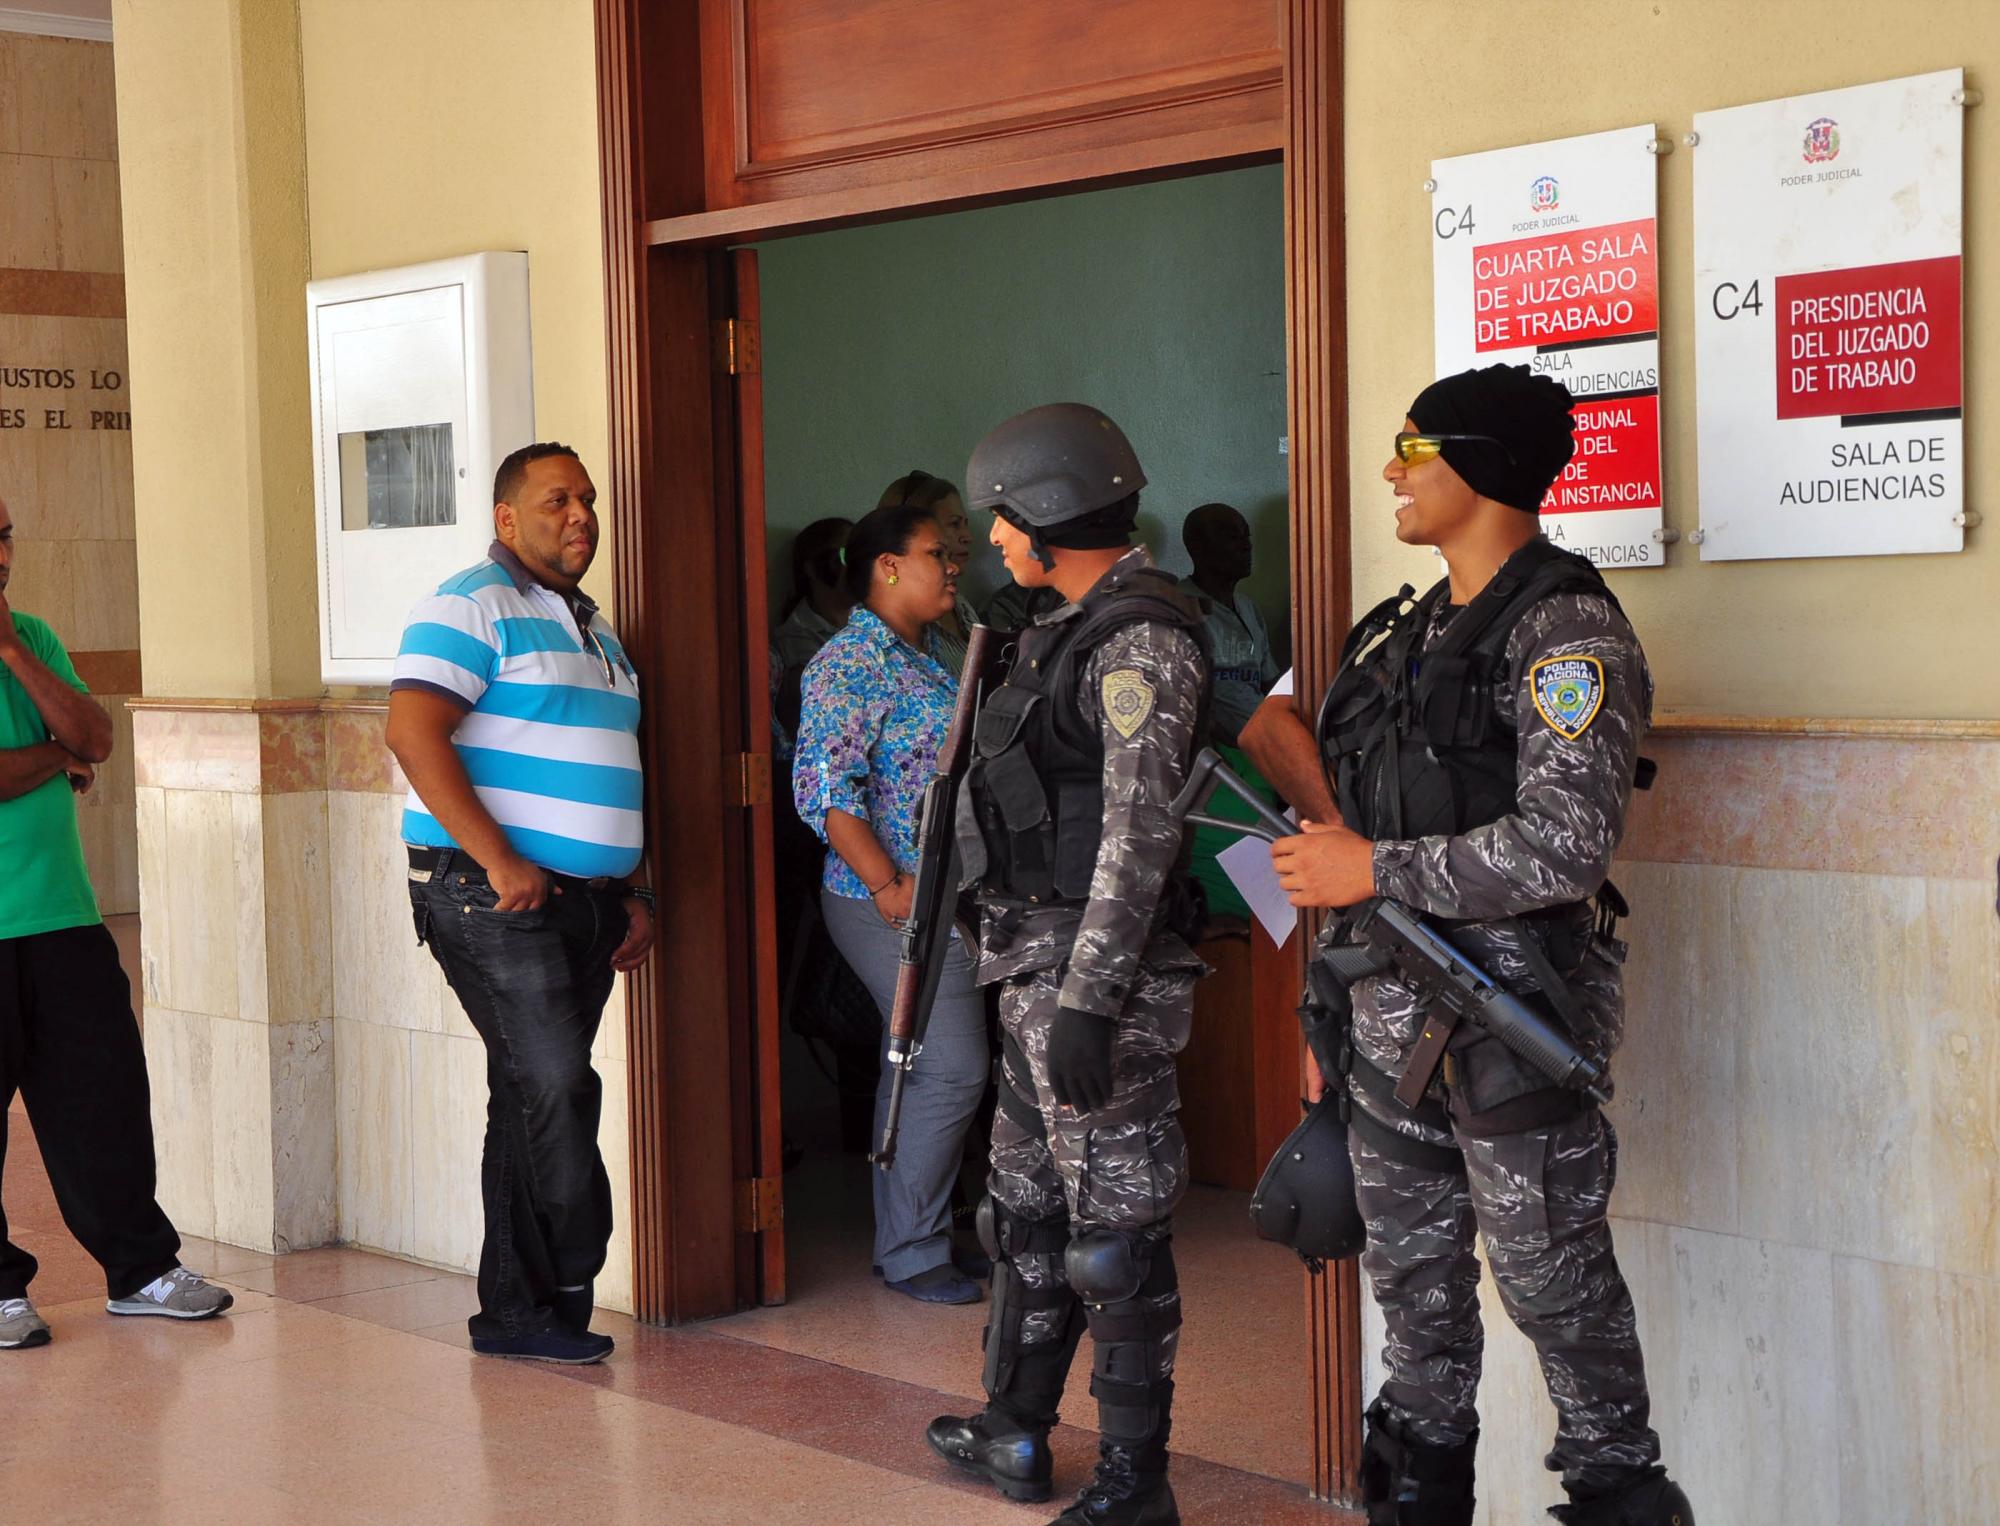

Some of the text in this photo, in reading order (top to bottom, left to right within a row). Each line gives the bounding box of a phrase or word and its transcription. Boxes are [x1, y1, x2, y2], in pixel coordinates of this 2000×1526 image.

[1781, 168, 1862, 187] PODER JUDICIAL
[1435, 204, 1476, 239] C4
[1512, 214, 1580, 232] PODER JUDICIAL
[1475, 232, 1648, 281] CUARTA SALA
[1476, 267, 1637, 312] DE JUZGADO
[1712, 279, 1763, 321] C4
[1791, 287, 1927, 326] PRESIDENCIA
[1477, 300, 1633, 344] DE TRABAJO
[1791, 321, 1930, 360] DEL JUZGADO
[1532, 352, 1573, 373] SALA
[90, 370, 122, 390] LO
[1561, 368, 1657, 394] UDIENCIAS
[1791, 357, 1916, 394] DE TRABAJO
[44, 410, 72, 430] EL
[1573, 409, 1638, 432] BUNAL
[1583, 436, 1618, 456] DEL
[1831, 437, 1945, 468] SALA DE
[1564, 462, 1589, 481] DE
[1561, 482, 1655, 507] INSTANCIA
[1779, 473, 1946, 506] AUDIENCIAS
[1537, 669, 1597, 687] NACIONAL
[1543, 661, 1588, 675] POLICIA
